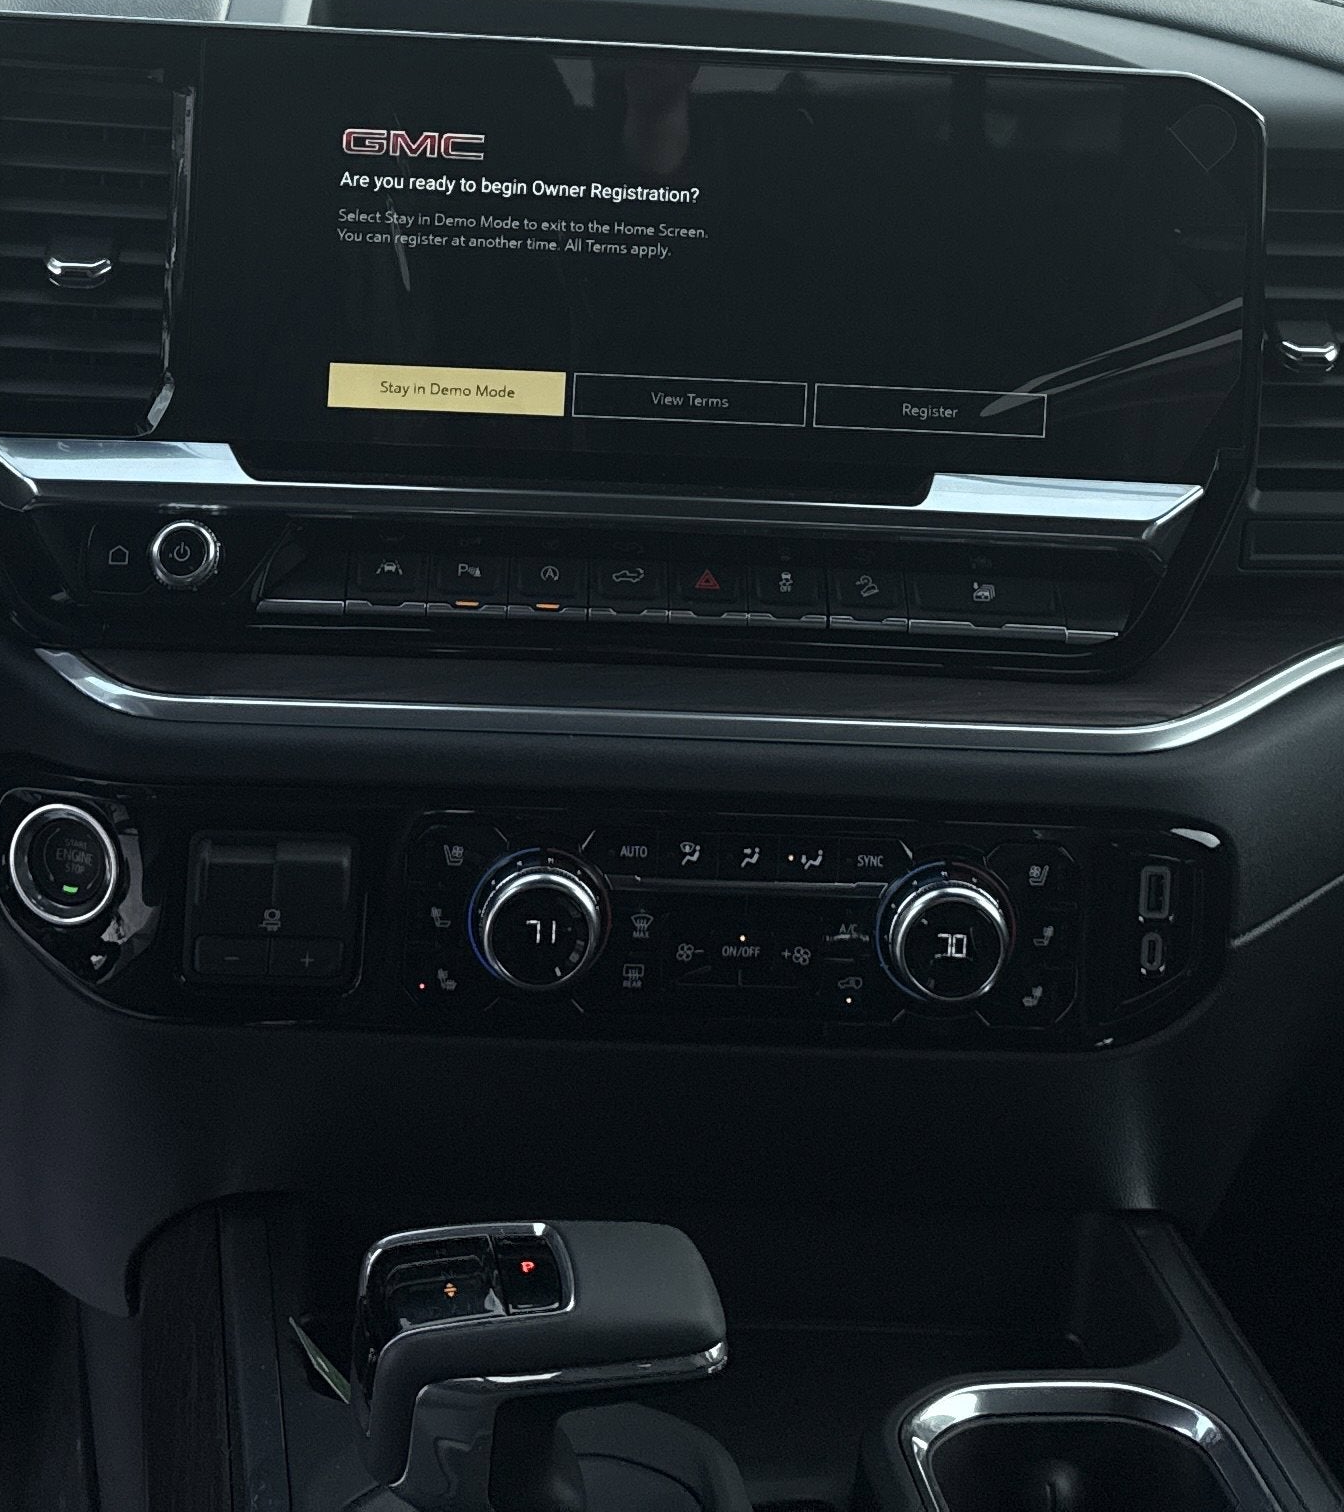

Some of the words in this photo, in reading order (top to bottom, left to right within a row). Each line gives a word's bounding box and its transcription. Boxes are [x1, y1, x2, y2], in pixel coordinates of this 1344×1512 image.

[342, 128, 485, 161] GMC
[339, 171, 370, 188] Are
[373, 176, 404, 192] you
[409, 175, 456, 195] ready
[460, 178, 476, 193] to
[481, 177, 527, 198] begin
[532, 180, 587, 198] Owner
[590, 182, 700, 203] Registration?
[338, 208, 382, 224] Select
[385, 210, 416, 228] Stay
[418, 213, 431, 226] in
[434, 213, 477, 228] Demo
[480, 215, 520, 230] Mode
[524, 218, 538, 231] to
[541, 219, 567, 232] exit
[570, 220, 585, 233] to
[587, 219, 610, 235] the
[614, 221, 656, 236] Home
[658, 223, 709, 239] Screen.
[337, 228, 363, 242] You
[366, 232, 391, 244] can
[394, 232, 447, 247] register
[451, 236, 465, 247] at
[468, 235, 524, 250] another
[527, 238, 561, 252] time.
[564, 239, 582, 253] All
[585, 239, 628, 255] Terms
[630, 242, 672, 260] apply.
[380, 380, 410, 397] Stay
[413, 383, 426, 395] in
[430, 382, 472, 397] Demo
[475, 384, 515, 399] Mode
[651, 391, 683, 406] View
[687, 393, 729, 408] Terms
[902, 403, 958, 420] Register
[65, 838, 87, 849] START
[620, 845, 648, 859] AUTO
[56, 848, 93, 865] ENGINE
[857, 854, 884, 869] SYNC
[64, 863, 86, 874] STOP
[526, 919, 556, 945] 71
[632, 930, 650, 939] MAX
[721, 945, 761, 959] ON/OFF
[520, 1261, 535, 1273] P
